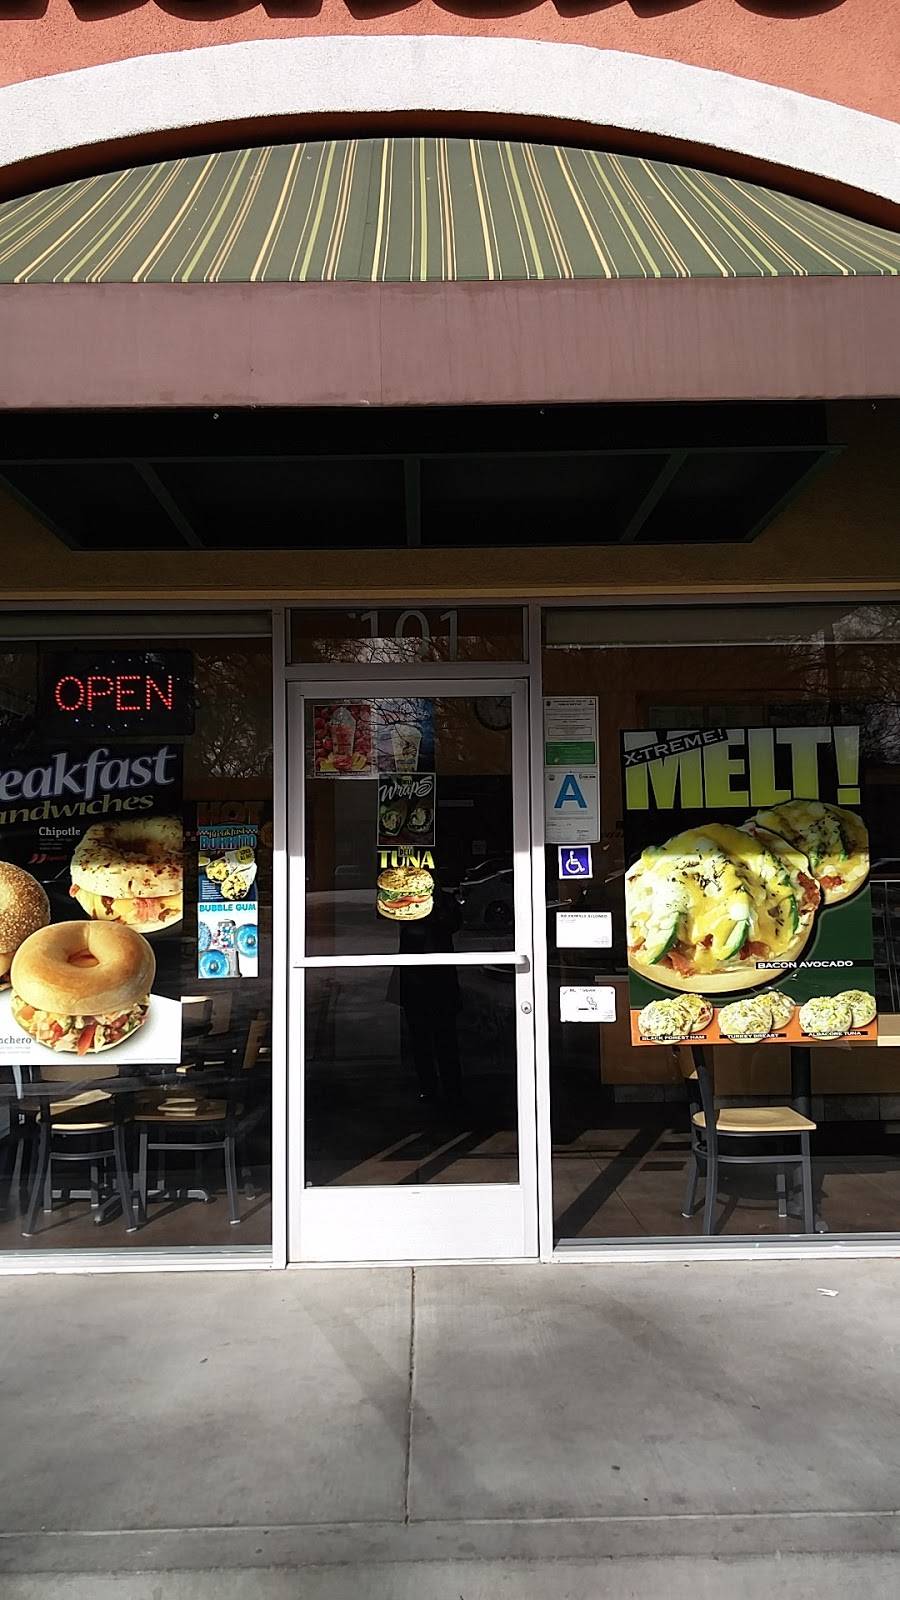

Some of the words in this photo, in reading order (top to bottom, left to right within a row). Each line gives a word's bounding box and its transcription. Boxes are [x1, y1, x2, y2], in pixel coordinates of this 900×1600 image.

[360, 609, 459, 661] 101
[55, 675, 173, 711] OPEN
[624, 728, 725, 765] X-TREME!
[0, 746, 177, 801] eakfast
[623, 725, 861, 810] MELT!
[554, 774, 588, 809] A
[38, 826, 81, 838] Chipotle
[377, 850, 435, 869] TUNA
[199, 903, 233, 912] BUBBLE
[235, 902, 257, 912] GUM
[757, 961, 797, 969] BACON
[799, 960, 854, 968] AVOCADO
